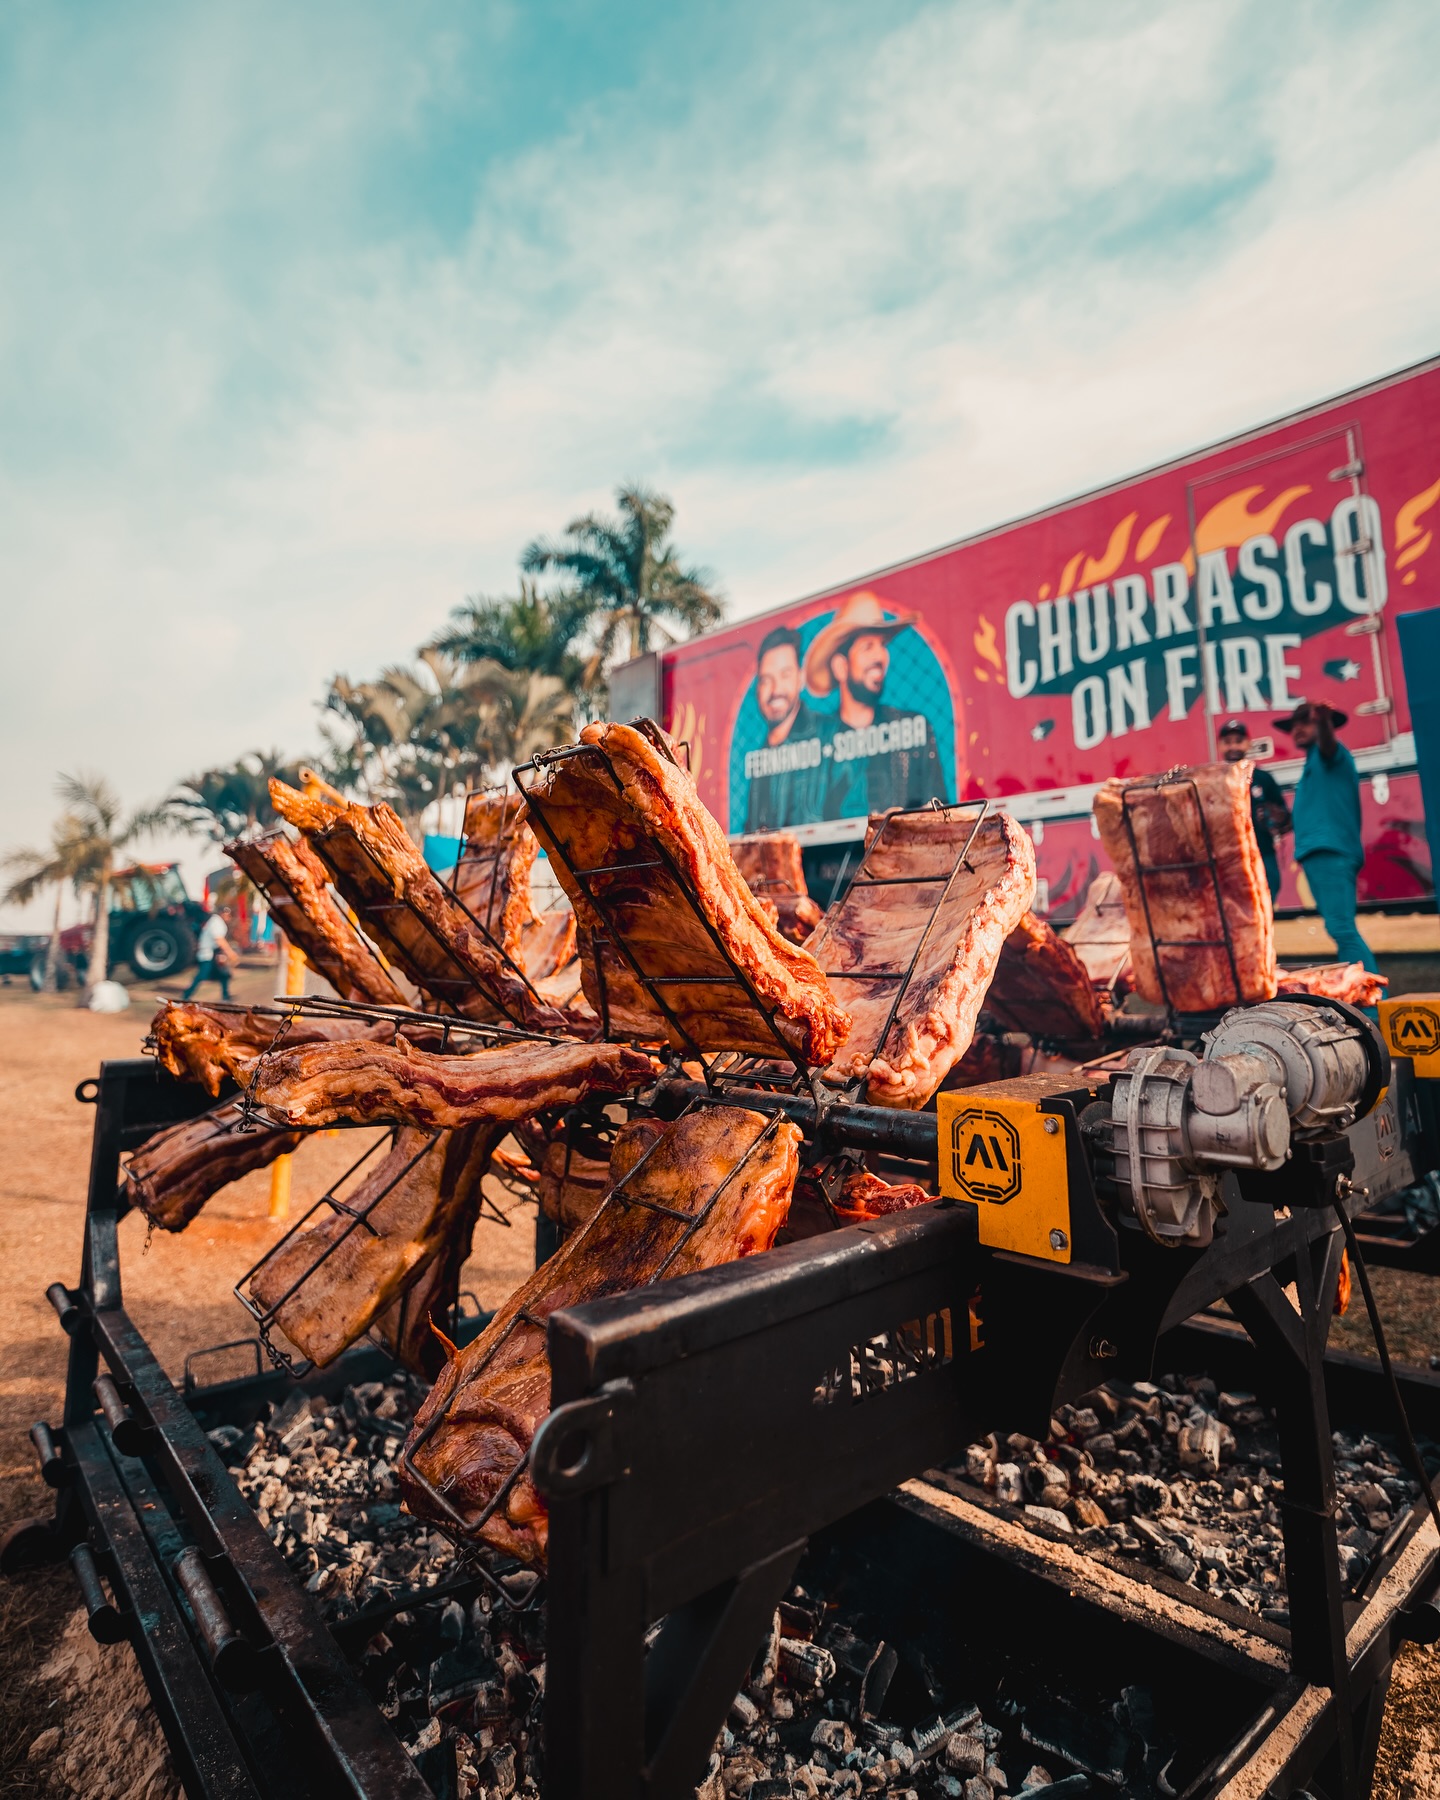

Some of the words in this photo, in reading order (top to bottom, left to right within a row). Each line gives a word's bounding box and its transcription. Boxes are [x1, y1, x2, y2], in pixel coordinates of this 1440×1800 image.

[1005, 494, 1389, 699] CHURRASCO
[744, 737, 821, 779] FERNANDO
[833, 714, 927, 763] SOROCABA
[1071, 657, 1152, 751] ON
[1163, 634, 1307, 722] FIRE
